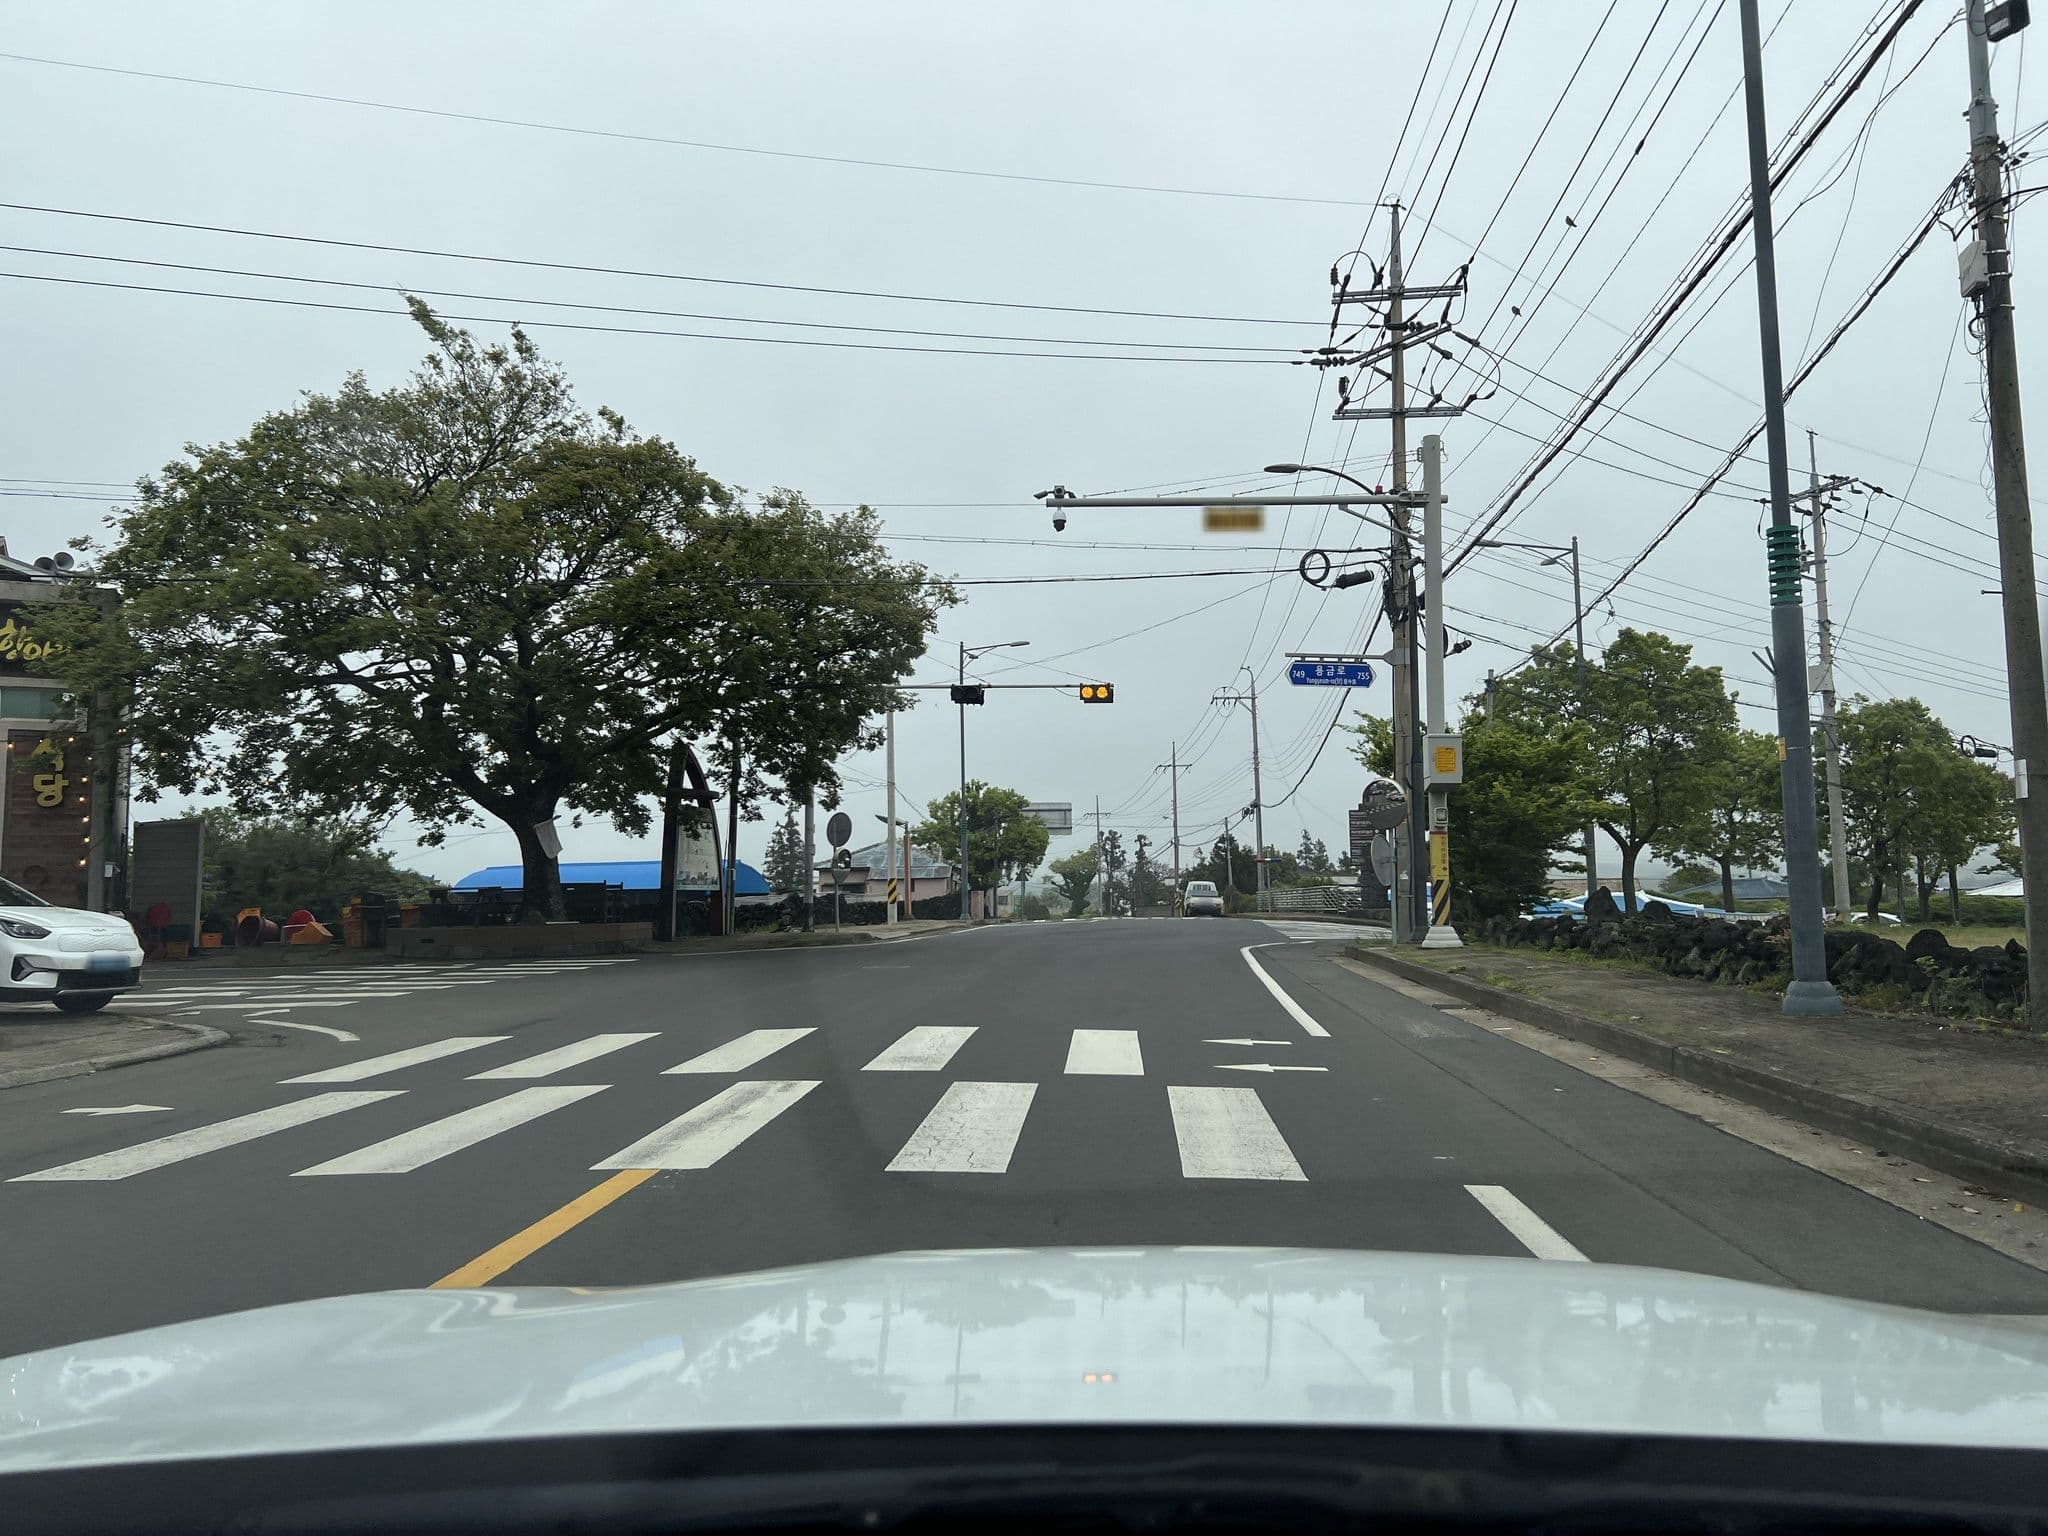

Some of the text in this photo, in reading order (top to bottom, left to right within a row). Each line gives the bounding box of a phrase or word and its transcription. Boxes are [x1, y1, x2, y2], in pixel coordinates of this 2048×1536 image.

[1292, 670, 1305, 679] 749
[1315, 665, 1346, 676] 용금로
[1357, 672, 1370, 680] 755
